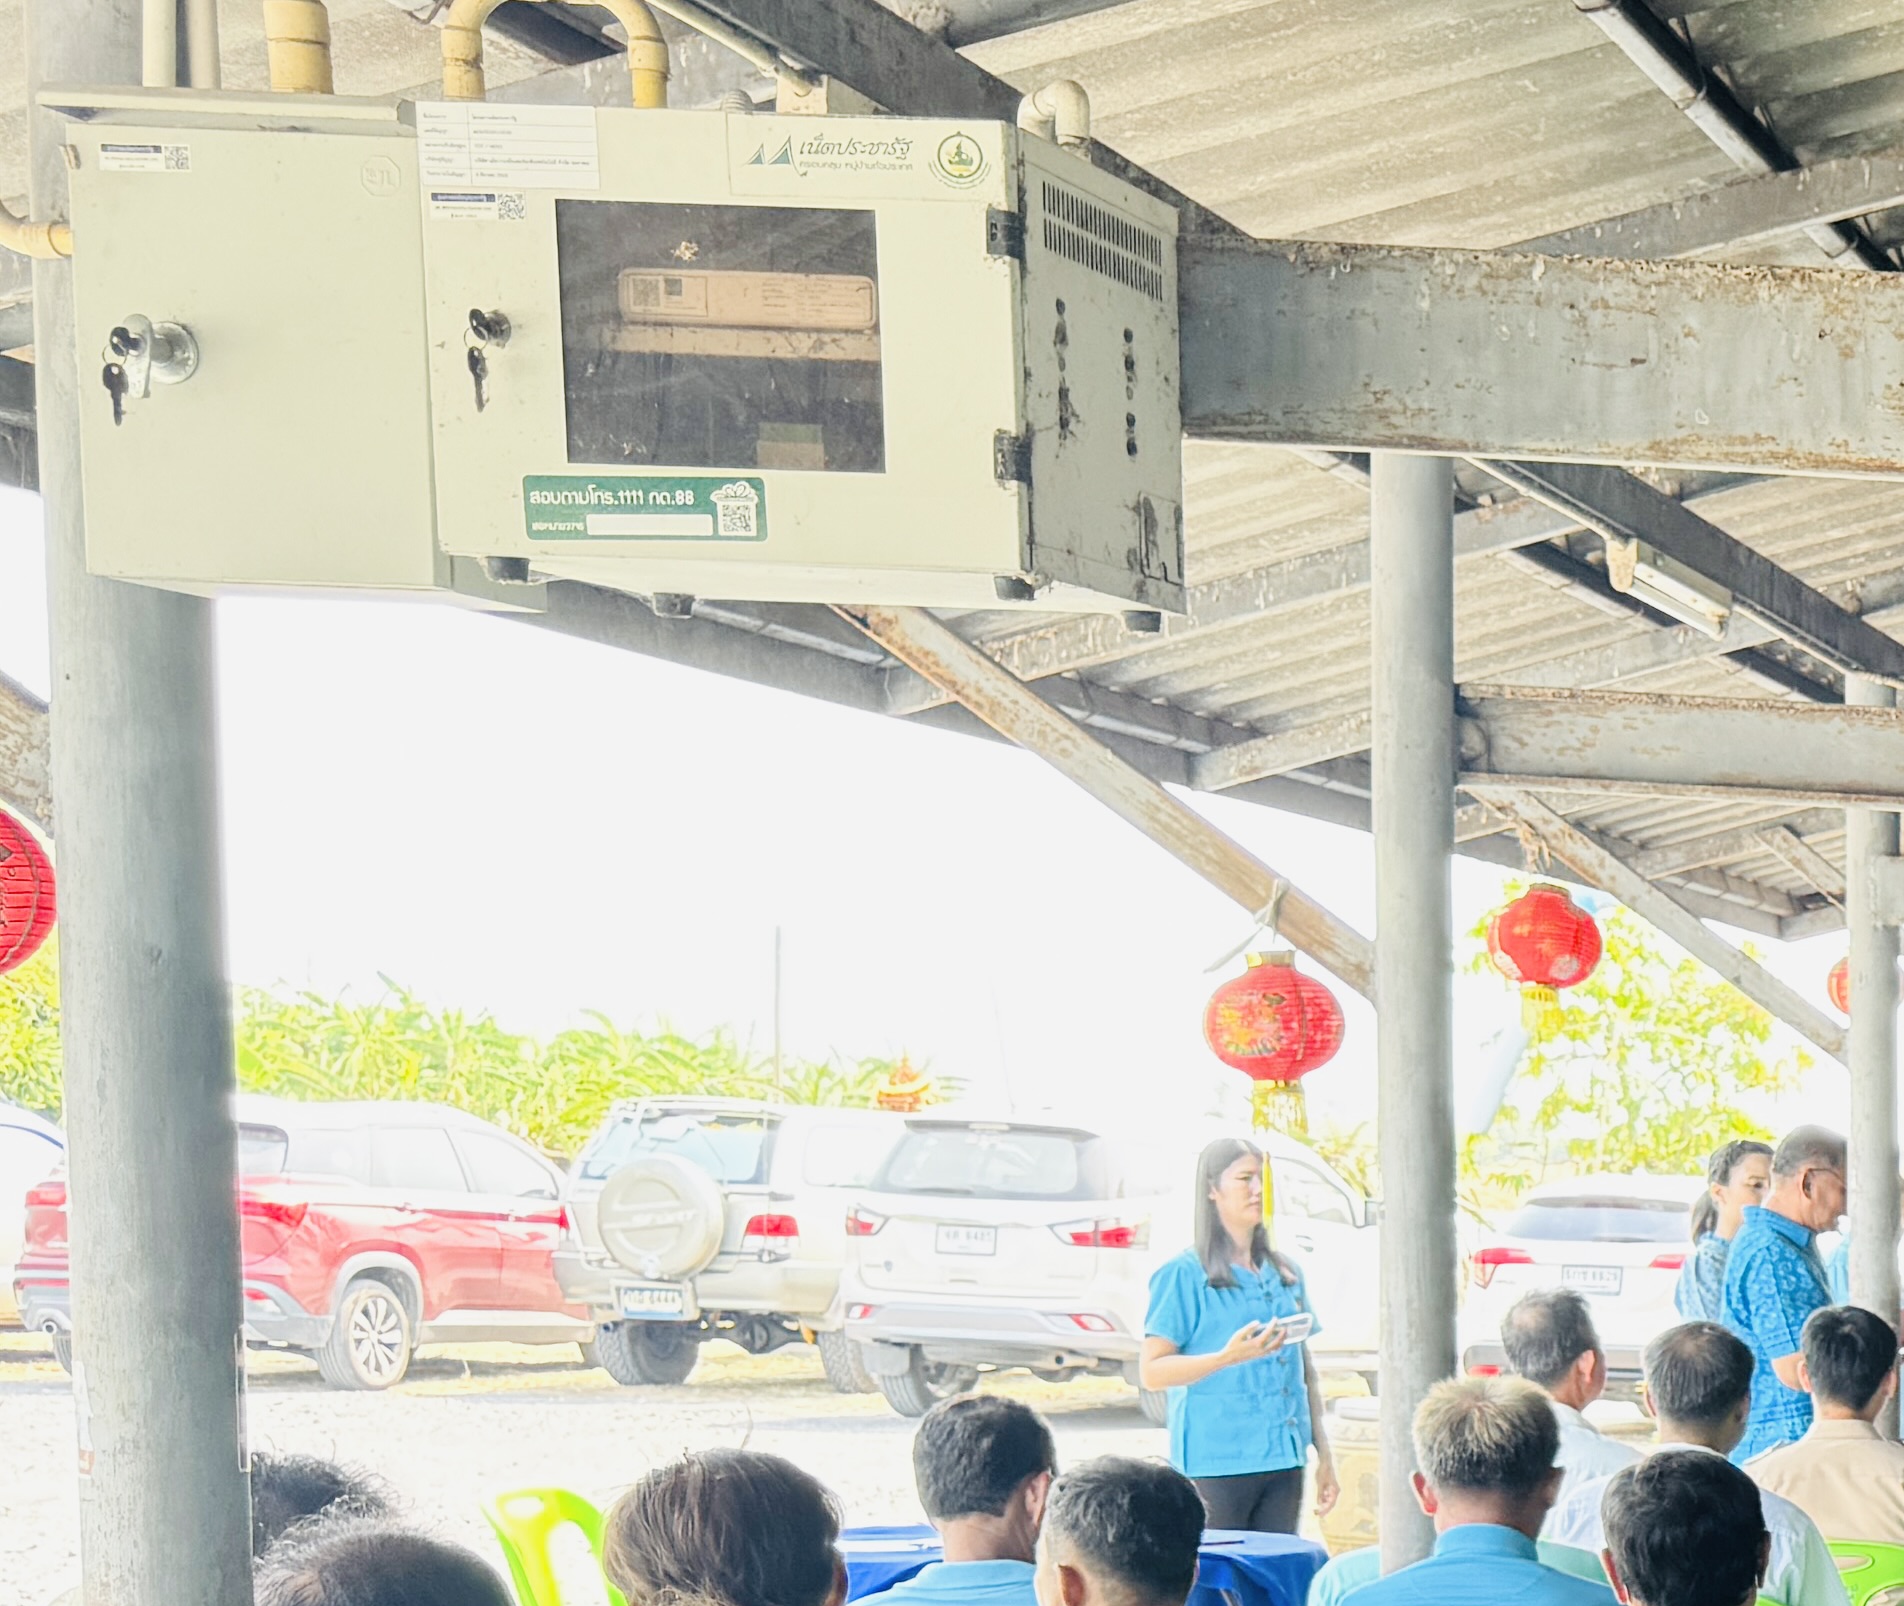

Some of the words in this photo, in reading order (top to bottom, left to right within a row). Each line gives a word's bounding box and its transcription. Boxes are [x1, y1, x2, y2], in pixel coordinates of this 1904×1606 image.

[799, 132, 913, 160] เน็ตประชารัฐ
